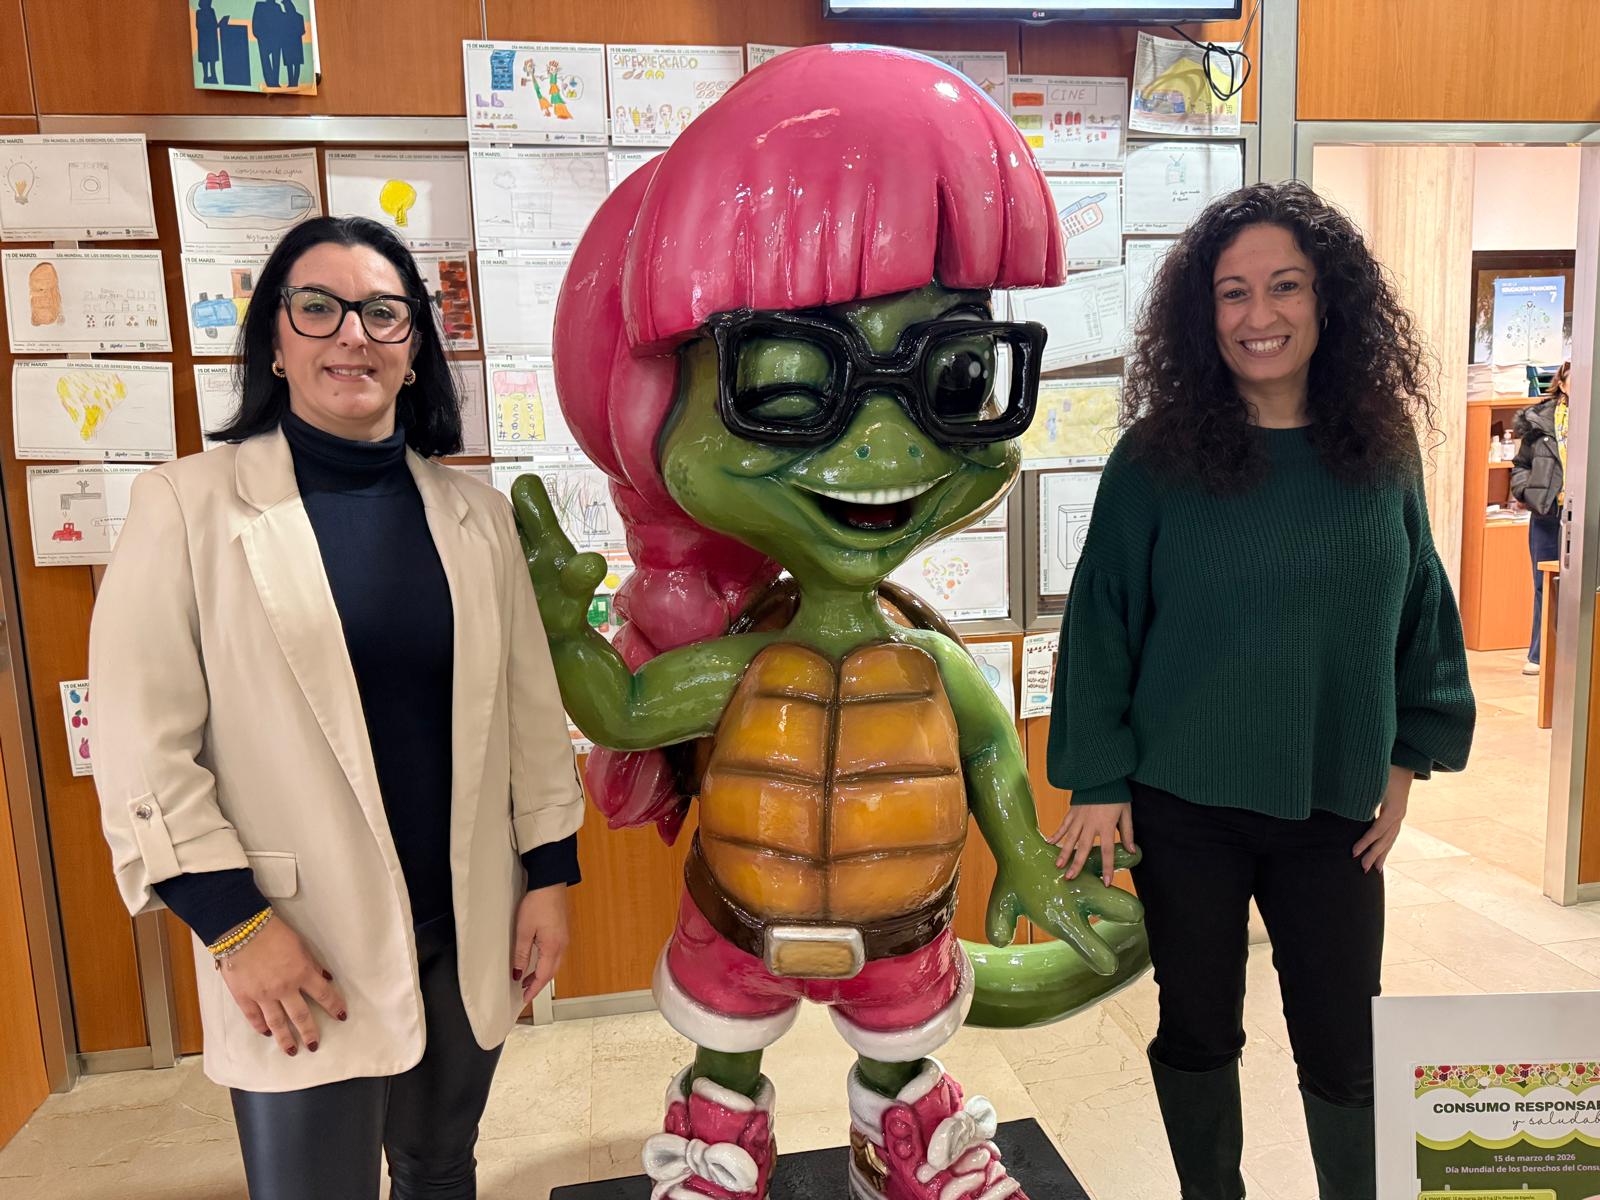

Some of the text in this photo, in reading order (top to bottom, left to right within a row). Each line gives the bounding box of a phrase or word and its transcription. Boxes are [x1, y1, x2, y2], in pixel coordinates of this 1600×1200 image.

[613, 54, 699, 70] SUPERMERCADO
[1050, 88, 1086, 101] CINE
[1549, 291, 1558, 304] 7
[512, 403, 519, 412] 2
[527, 403, 534, 412] 3
[511, 422, 519, 430] 8
[1433, 1102, 1510, 1113] CONSUMO
[1512, 1118, 1525, 1132] y
[1494, 1155, 1503, 1163] 15
[1505, 1154, 1516, 1162] de
[1545, 1153, 1556, 1162] de
[1556, 1153, 1577, 1161] 2026
[1445, 1166, 1460, 1174] Día
[1461, 1165, 1495, 1174] Mundial
[1496, 1165, 1508, 1173] de
[1508, 1164, 1521, 1173] los
[1522, 1164, 1561, 1173] Derechos
[1562, 1163, 1575, 1172] del
